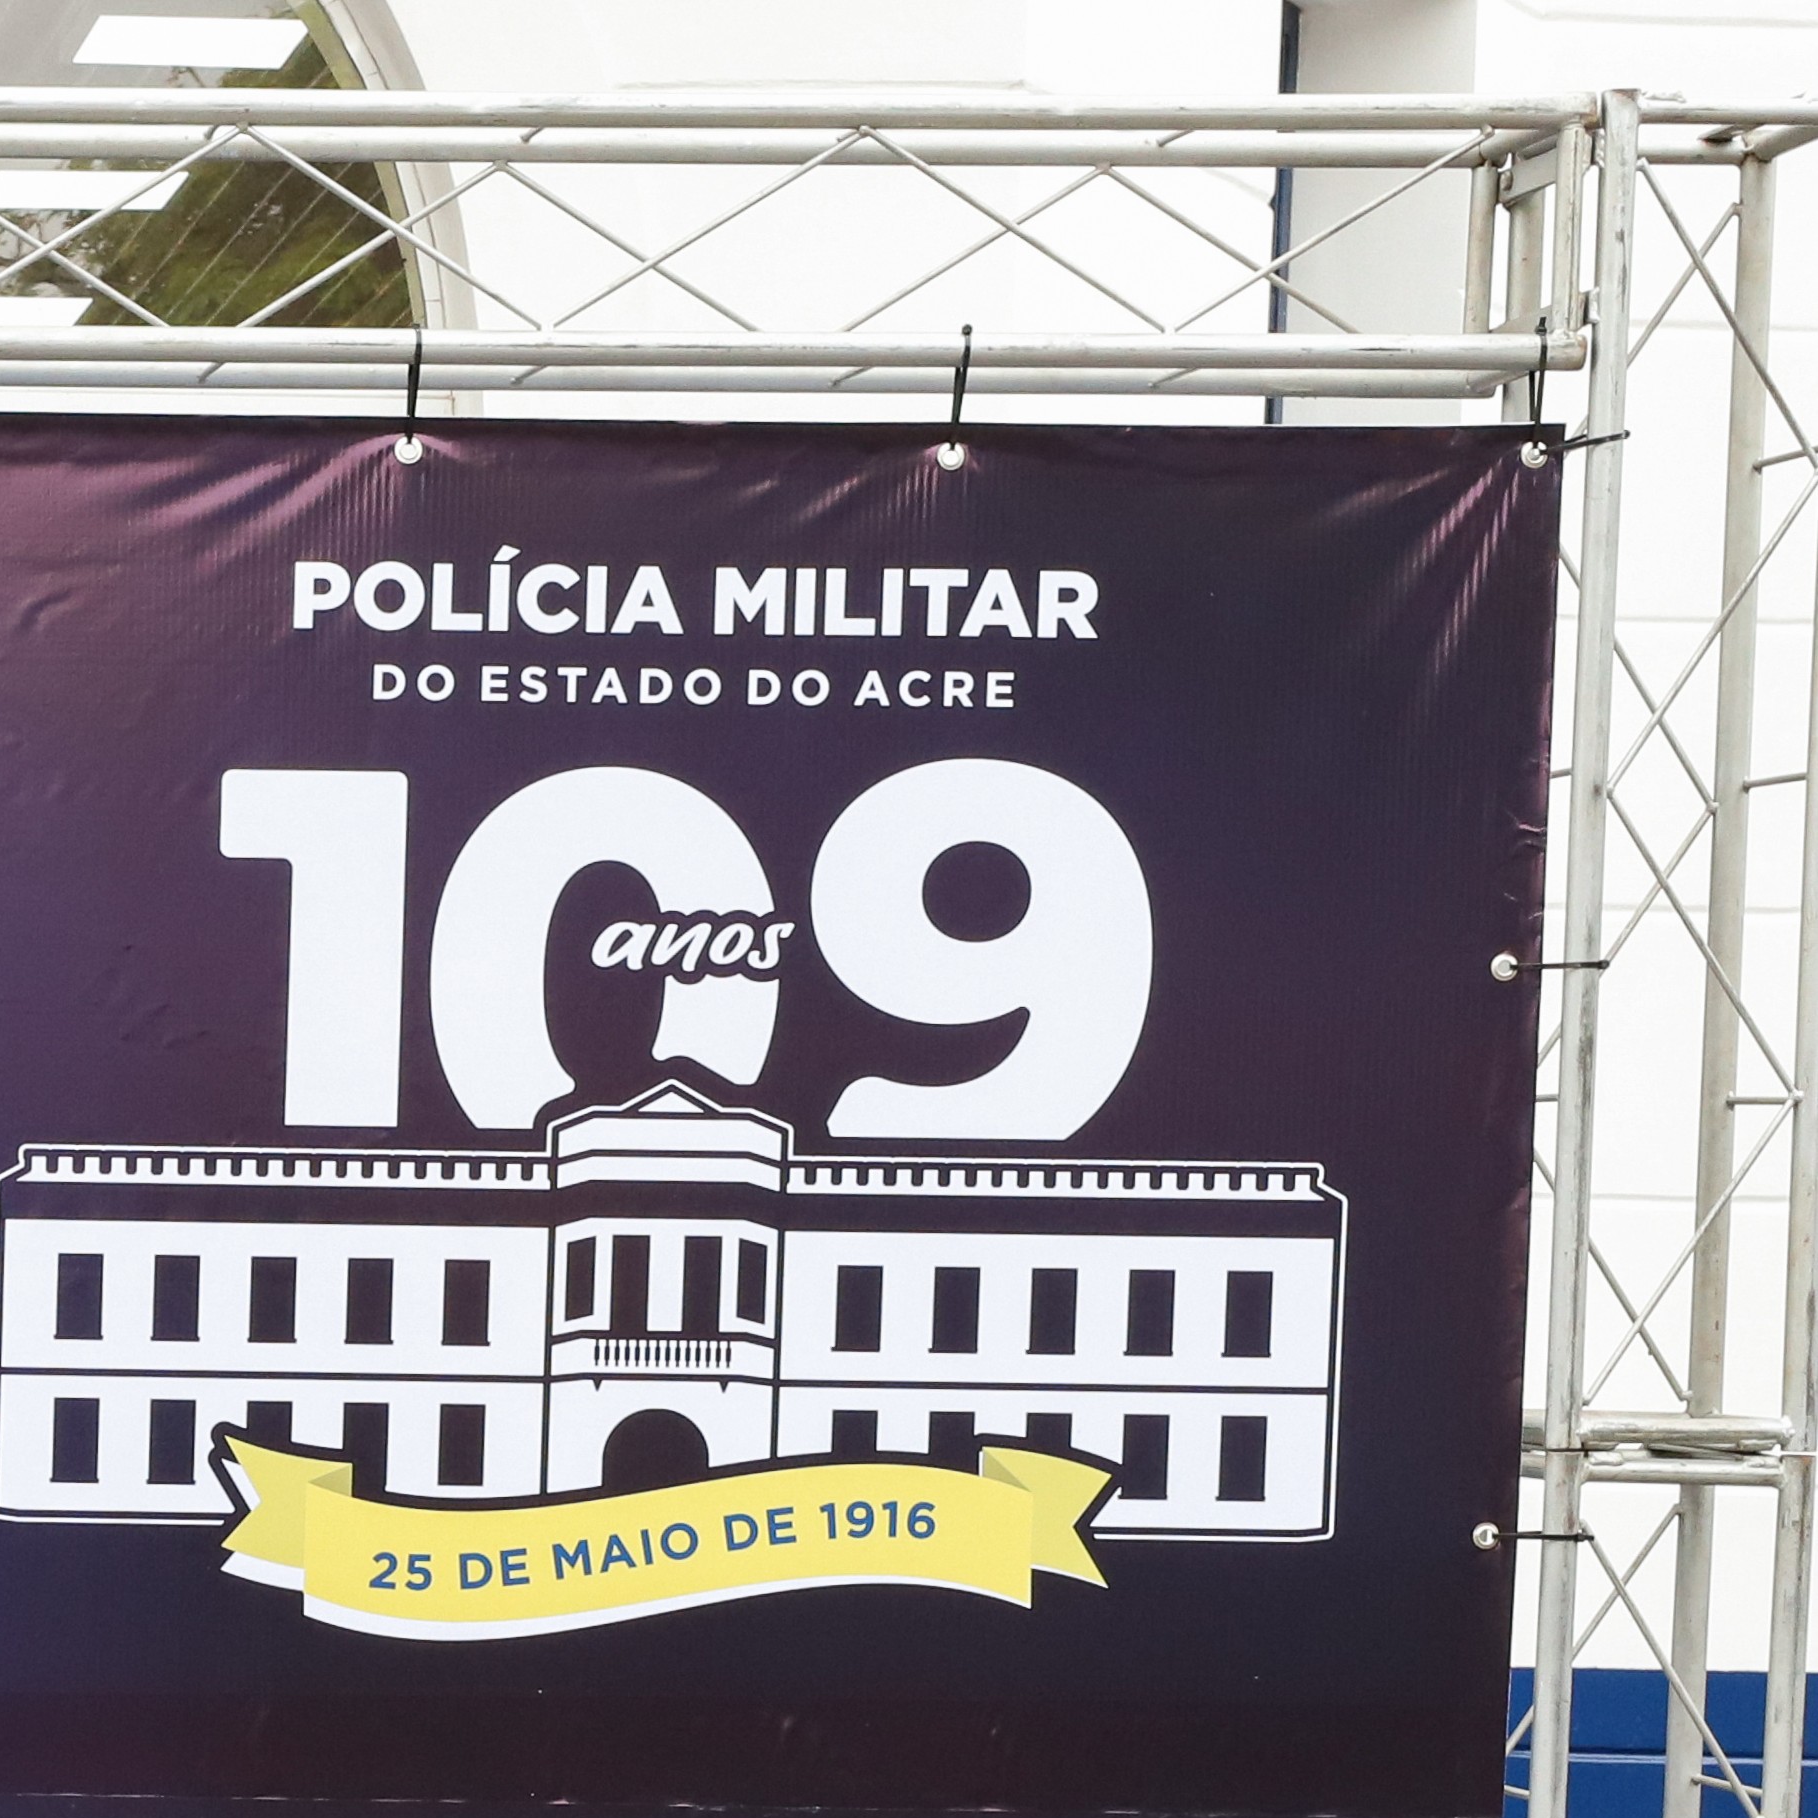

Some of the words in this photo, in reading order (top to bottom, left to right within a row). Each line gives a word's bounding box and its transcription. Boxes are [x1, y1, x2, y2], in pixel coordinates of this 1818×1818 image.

[291, 545, 683, 637] POLÍCIA
[714, 563, 1100, 642] MILITAR
[371, 663, 457, 704] DO
[479, 663, 724, 706] ESTADO
[746, 665, 835, 707] DO
[853, 668, 1017, 709] ACRE
[219, 757, 1154, 1142] 109
[589, 909, 795, 974] anos
[368, 1549, 436, 1594] 25
[456, 1545, 534, 1592] DE
[552, 1518, 701, 1581] MAIO
[723, 1505, 797, 1552] DE
[818, 1498, 939, 1545] 1916
